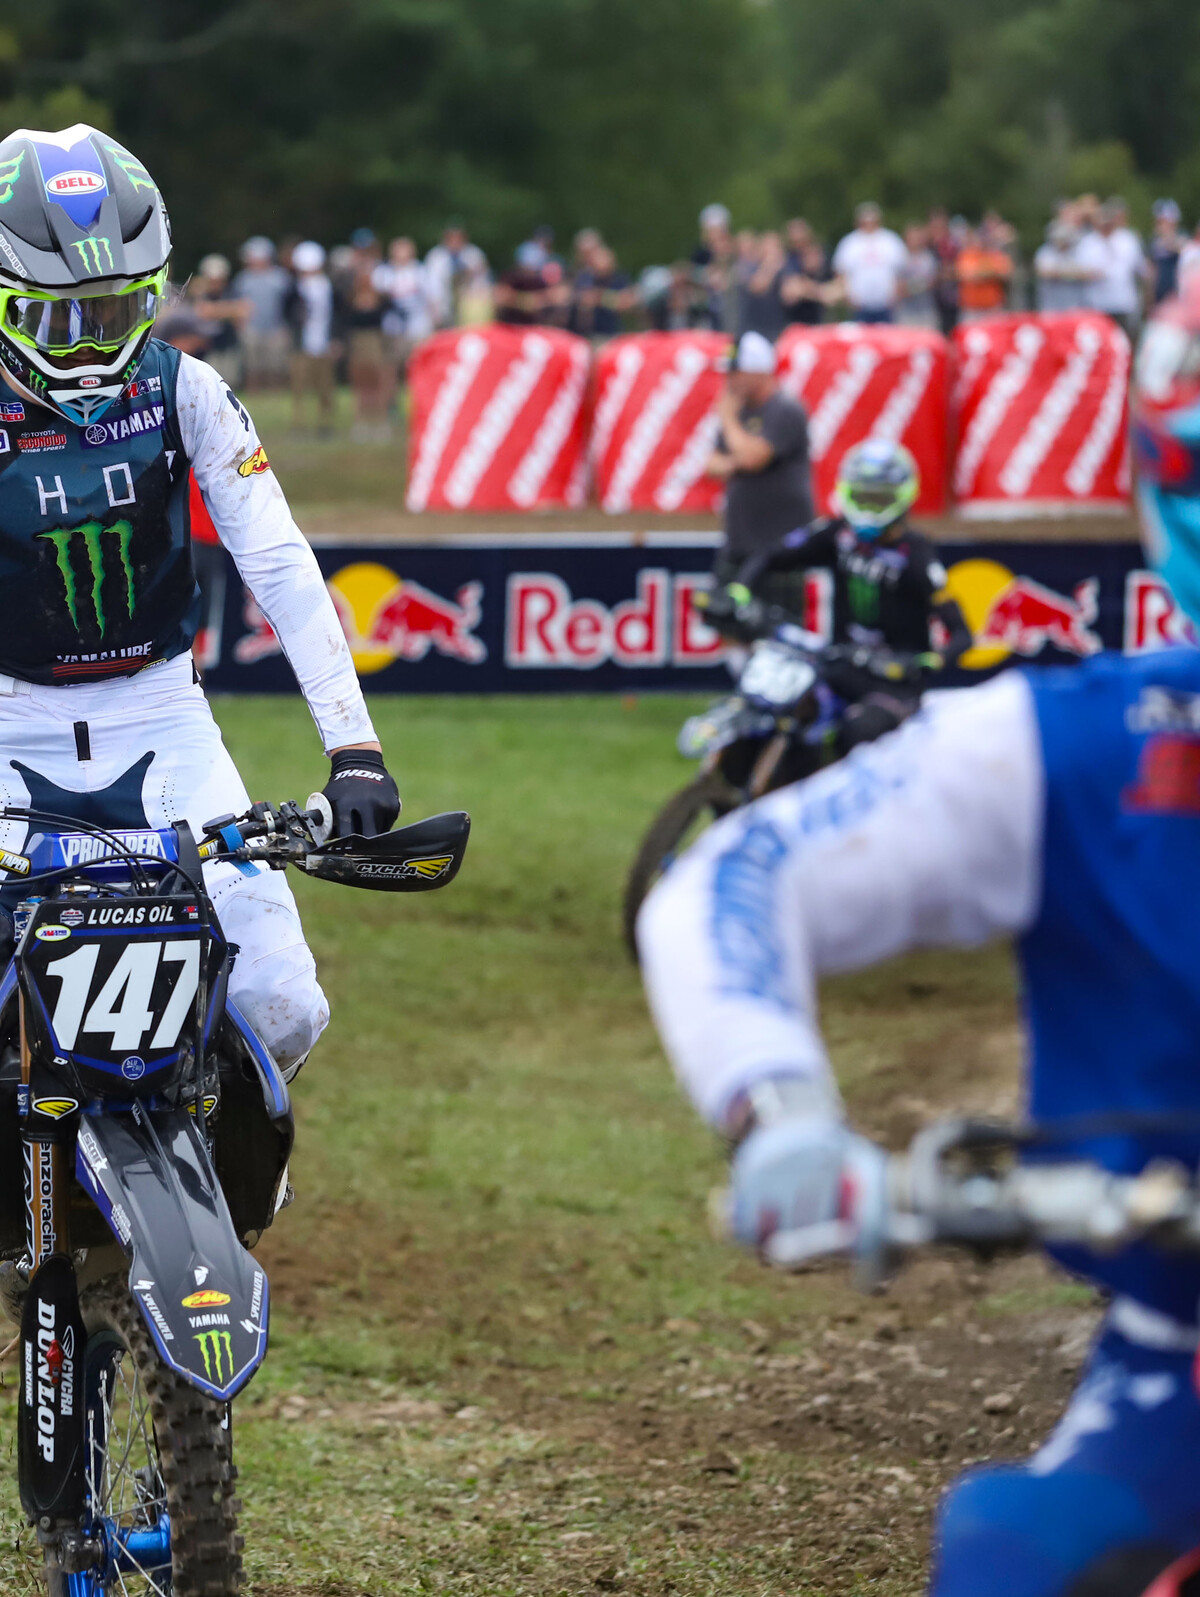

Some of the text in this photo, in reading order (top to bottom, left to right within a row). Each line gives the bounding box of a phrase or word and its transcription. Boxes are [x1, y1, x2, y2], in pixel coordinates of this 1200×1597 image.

[55, 177, 98, 190] BELL
[17, 434, 68, 449] ESCONDIDO
[504, 567, 670, 670] Red
[334, 768, 386, 782] THOR
[66, 835, 161, 868] PROTAPER
[356, 863, 419, 876] CYCRA
[87, 908, 146, 925] LUCAS
[148, 906, 175, 923] OIL
[46, 939, 201, 1051] 147
[250, 1270, 263, 1320] SPECIALIZED
[140, 1292, 175, 1341] SPECIALIZED
[188, 1313, 231, 1329] YAMAHA
[25, 1340, 34, 1408] BRAKING
[37, 1297, 56, 1464] DUNLOP
[60, 1358, 75, 1416] CYCRA
